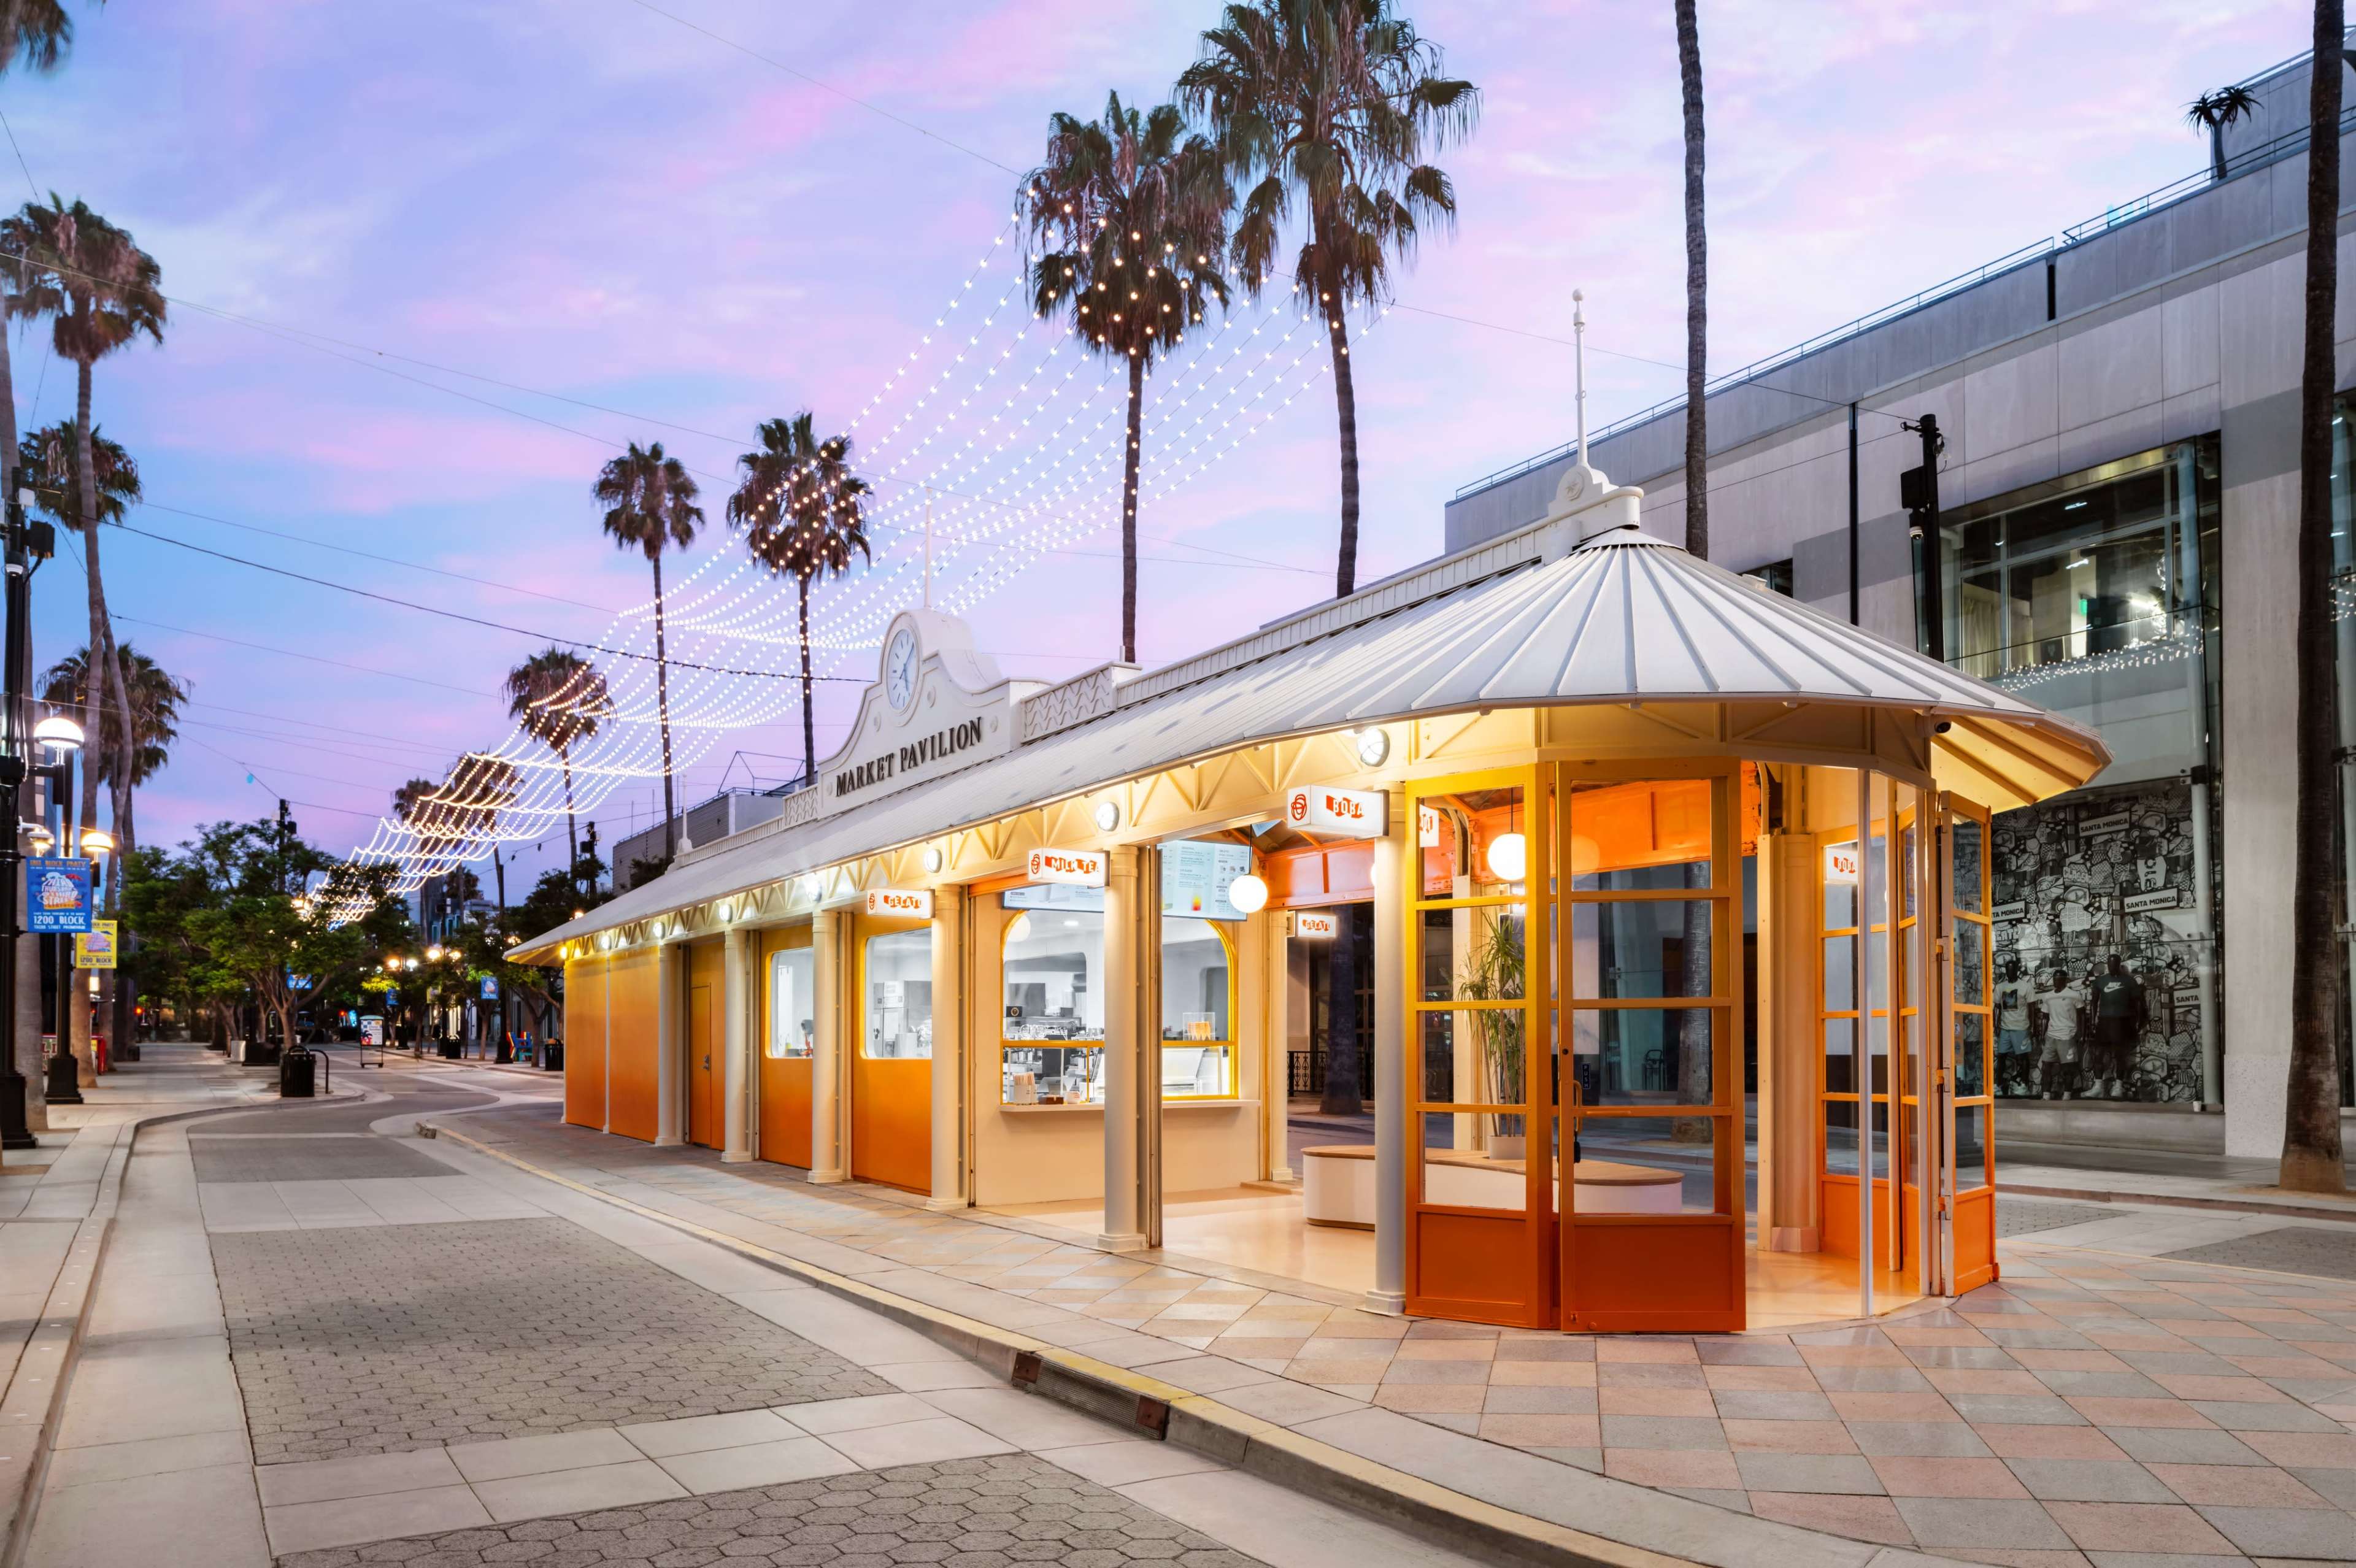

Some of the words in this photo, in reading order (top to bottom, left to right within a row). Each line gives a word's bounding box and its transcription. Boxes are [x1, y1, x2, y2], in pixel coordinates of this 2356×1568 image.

[836, 752, 895, 797] MARKET
[899, 716, 982, 773] PAVILION
[1331, 797, 1365, 817] BOBA
[2080, 823, 2101, 833] SANTA
[2103, 818, 2128, 828] MONICA
[1051, 858, 1076, 872] MILK
[1082, 860, 1099, 873] TEA
[2126, 899, 2148, 909] SANTA
[2149, 896, 2176, 906] MONICA
[2001, 907, 2024, 917] MONICA
[34, 916, 54, 924] 1200
[59, 916, 85, 925] BLOCK
[2176, 994, 2199, 1003] SANTA
